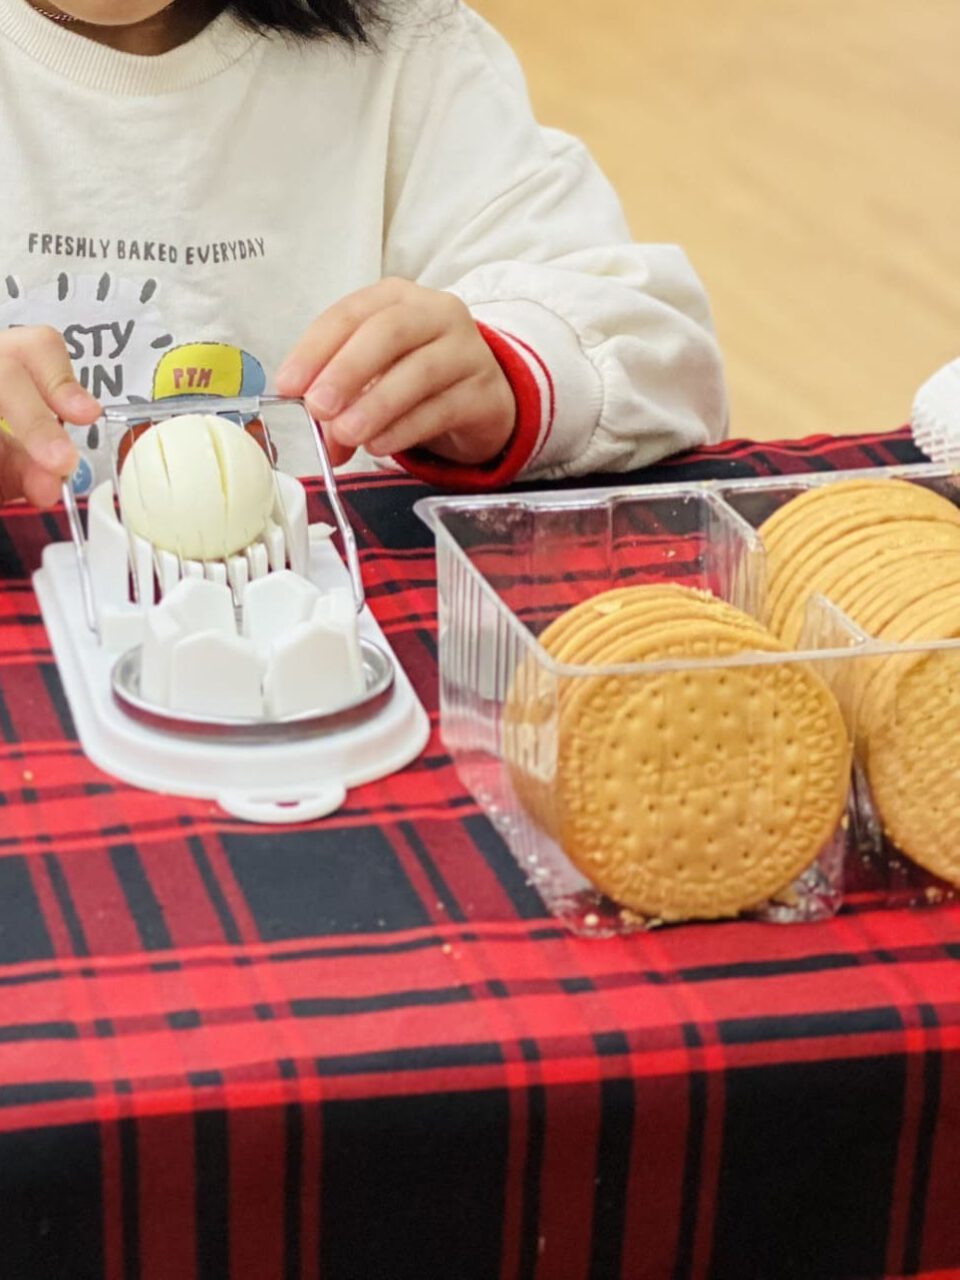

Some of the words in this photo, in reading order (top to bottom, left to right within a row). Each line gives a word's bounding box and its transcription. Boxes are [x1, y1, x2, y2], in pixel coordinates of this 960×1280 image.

[28, 233, 110, 259] FRESHLY
[117, 239, 178, 264] BAKED
[185, 238, 266, 265] EVERYDAY
